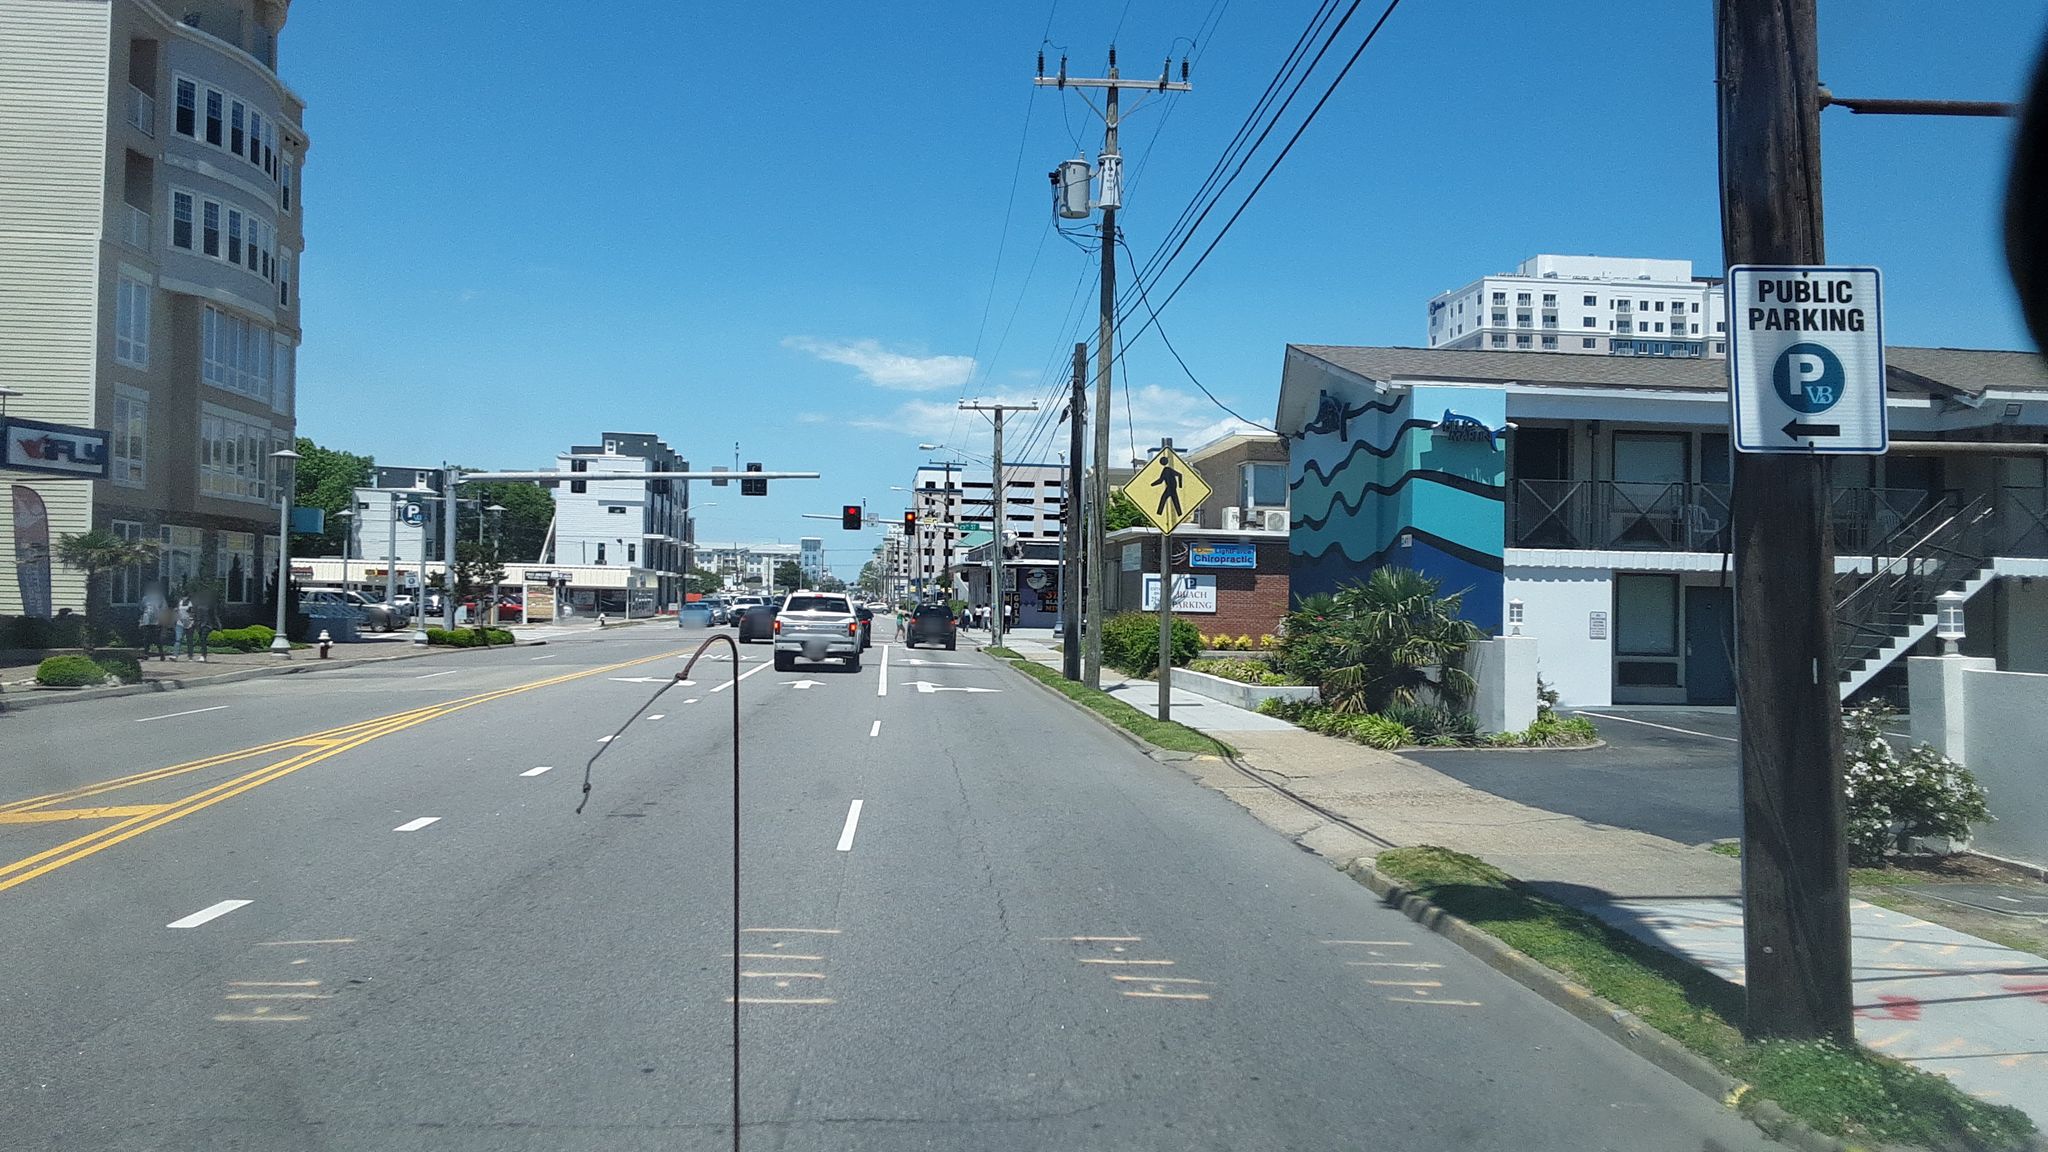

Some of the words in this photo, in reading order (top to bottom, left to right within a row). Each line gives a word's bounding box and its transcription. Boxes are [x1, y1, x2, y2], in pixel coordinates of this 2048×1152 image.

[1758, 280, 1853, 304] PUBLIC
[1748, 308, 1865, 332] PARKING
[1788, 353, 1825, 396] P
[1805, 385, 1834, 404] VB
[1193, 554, 1254, 564] Chiropractic
[1172, 600, 1212, 609] PARKING
